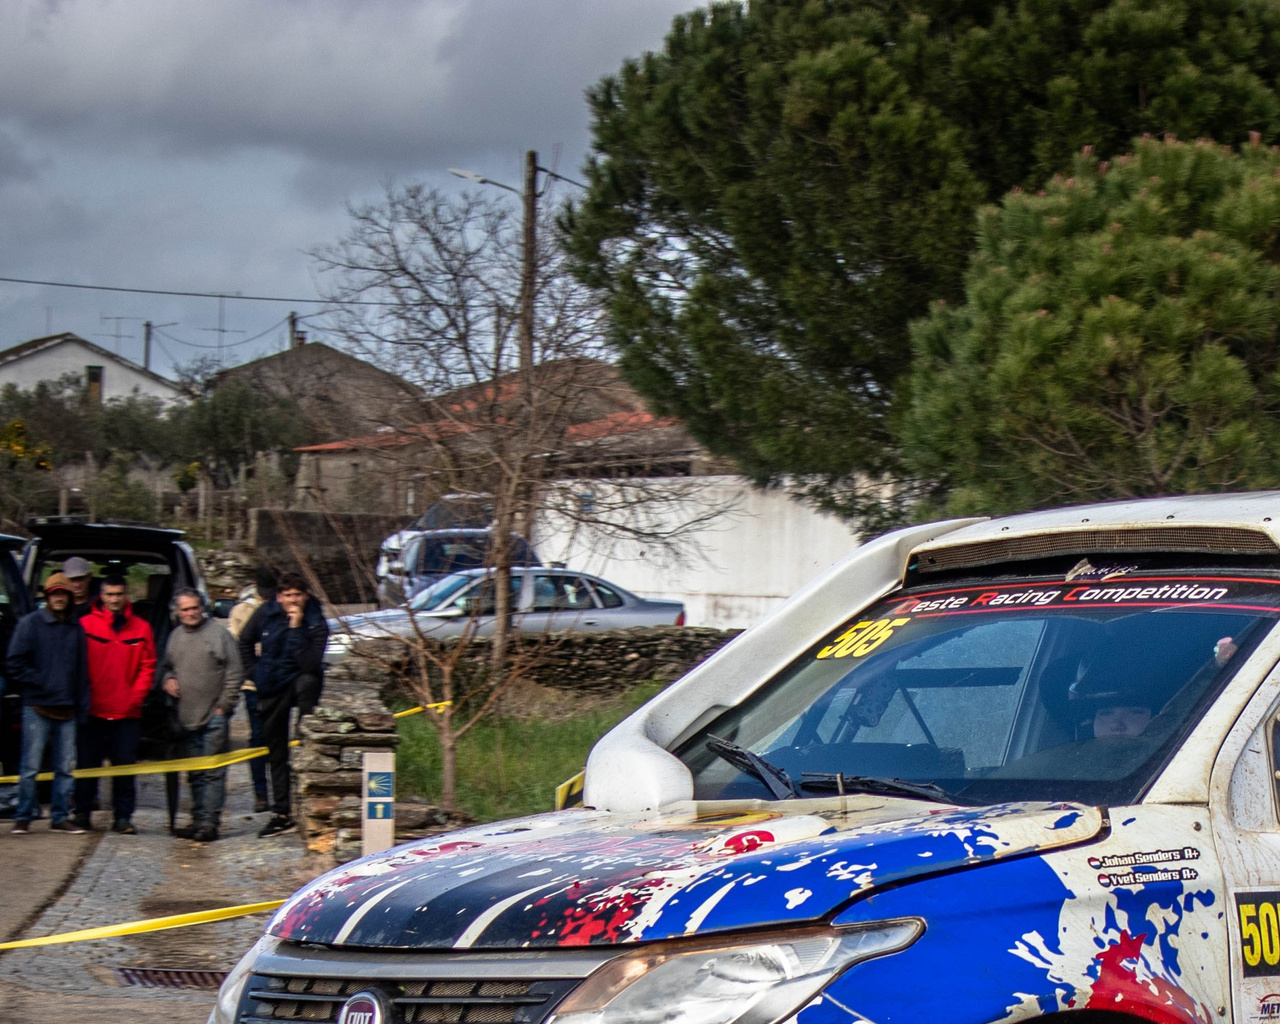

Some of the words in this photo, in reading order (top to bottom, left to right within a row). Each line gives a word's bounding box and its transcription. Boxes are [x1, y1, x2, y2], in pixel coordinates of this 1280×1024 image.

[893, 596, 969, 615] Oeste
[970, 588, 1062, 606] Racing
[1063, 584, 1229, 603] Competition
[816, 617, 912, 660] 505
[408, 830, 776, 860] SDERS
[1102, 856, 1135, 867] Johan
[1135, 850, 1181, 864] Senders
[1184, 848, 1199, 859] A+
[1110, 874, 1136, 886] Yvet
[1136, 870, 1180, 883] Senders
[1182, 868, 1197, 879] A+
